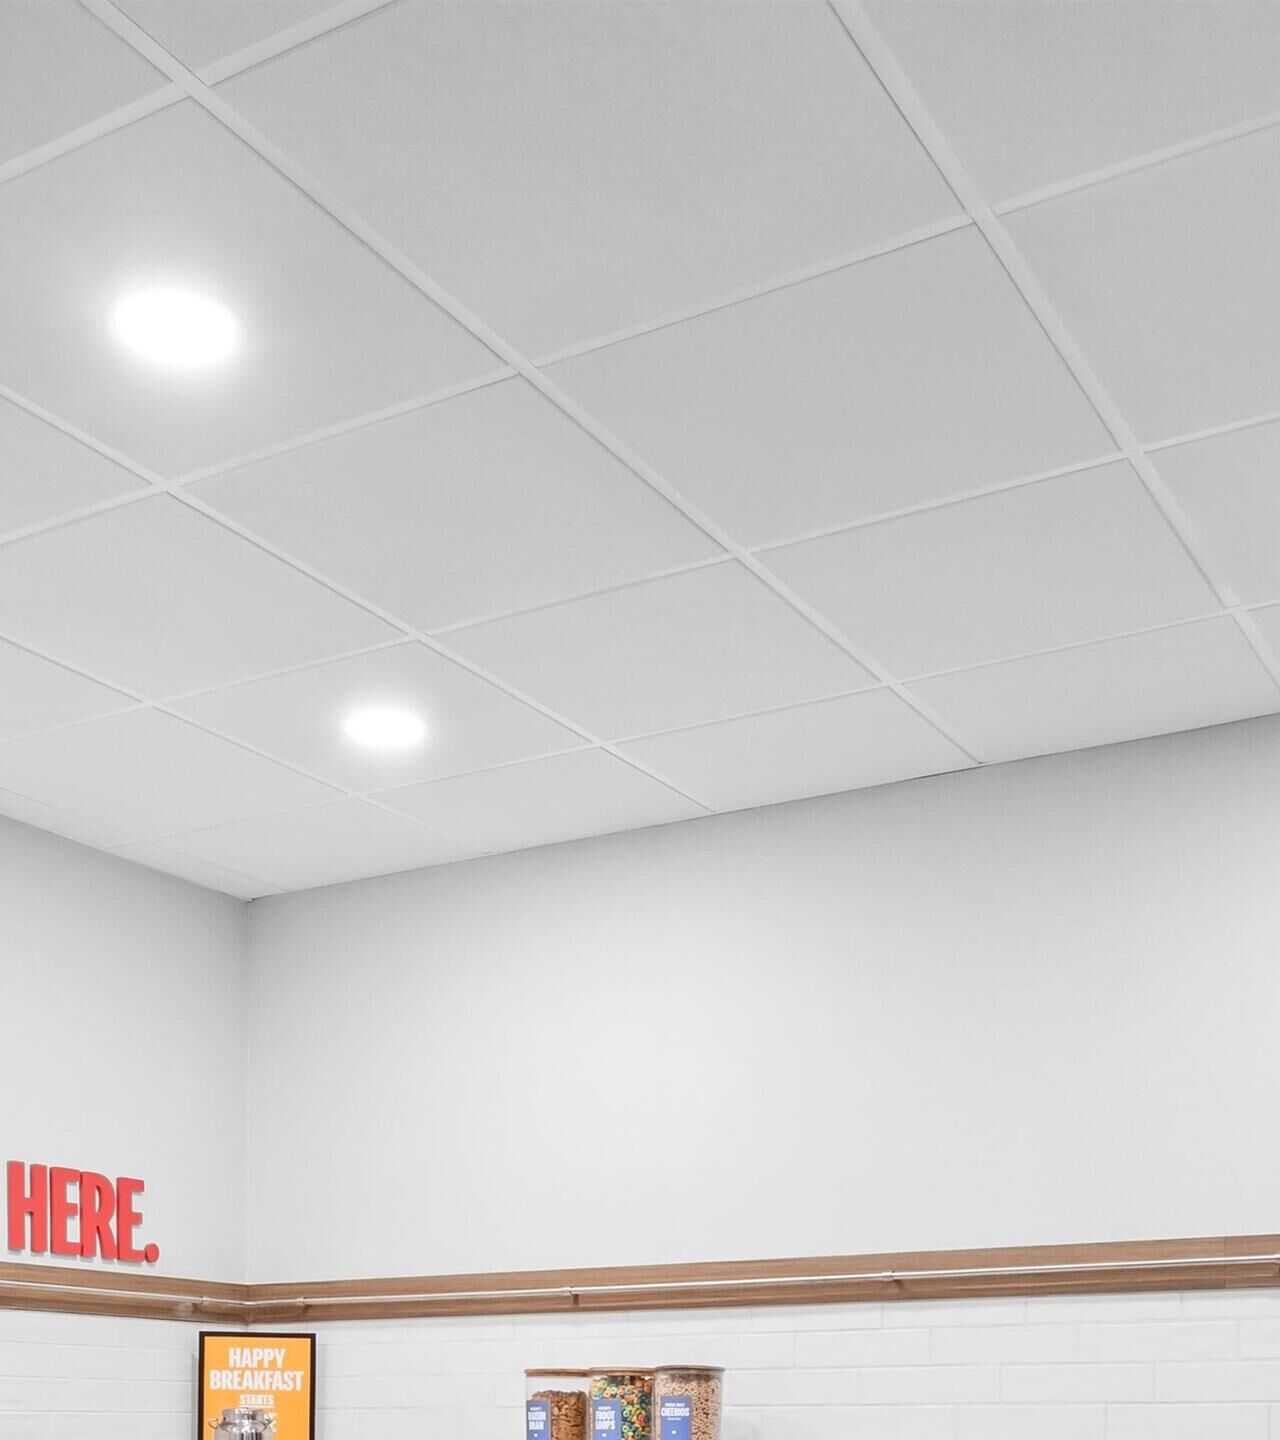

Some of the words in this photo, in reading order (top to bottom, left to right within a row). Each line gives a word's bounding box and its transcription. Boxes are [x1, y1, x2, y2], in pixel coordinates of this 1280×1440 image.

[7, 1161, 159, 1263] HERE.
[228, 1347, 286, 1369] HAPPY
[209, 1370, 304, 1391] BREAKFAST
[239, 1394, 274, 1406] STARTS
